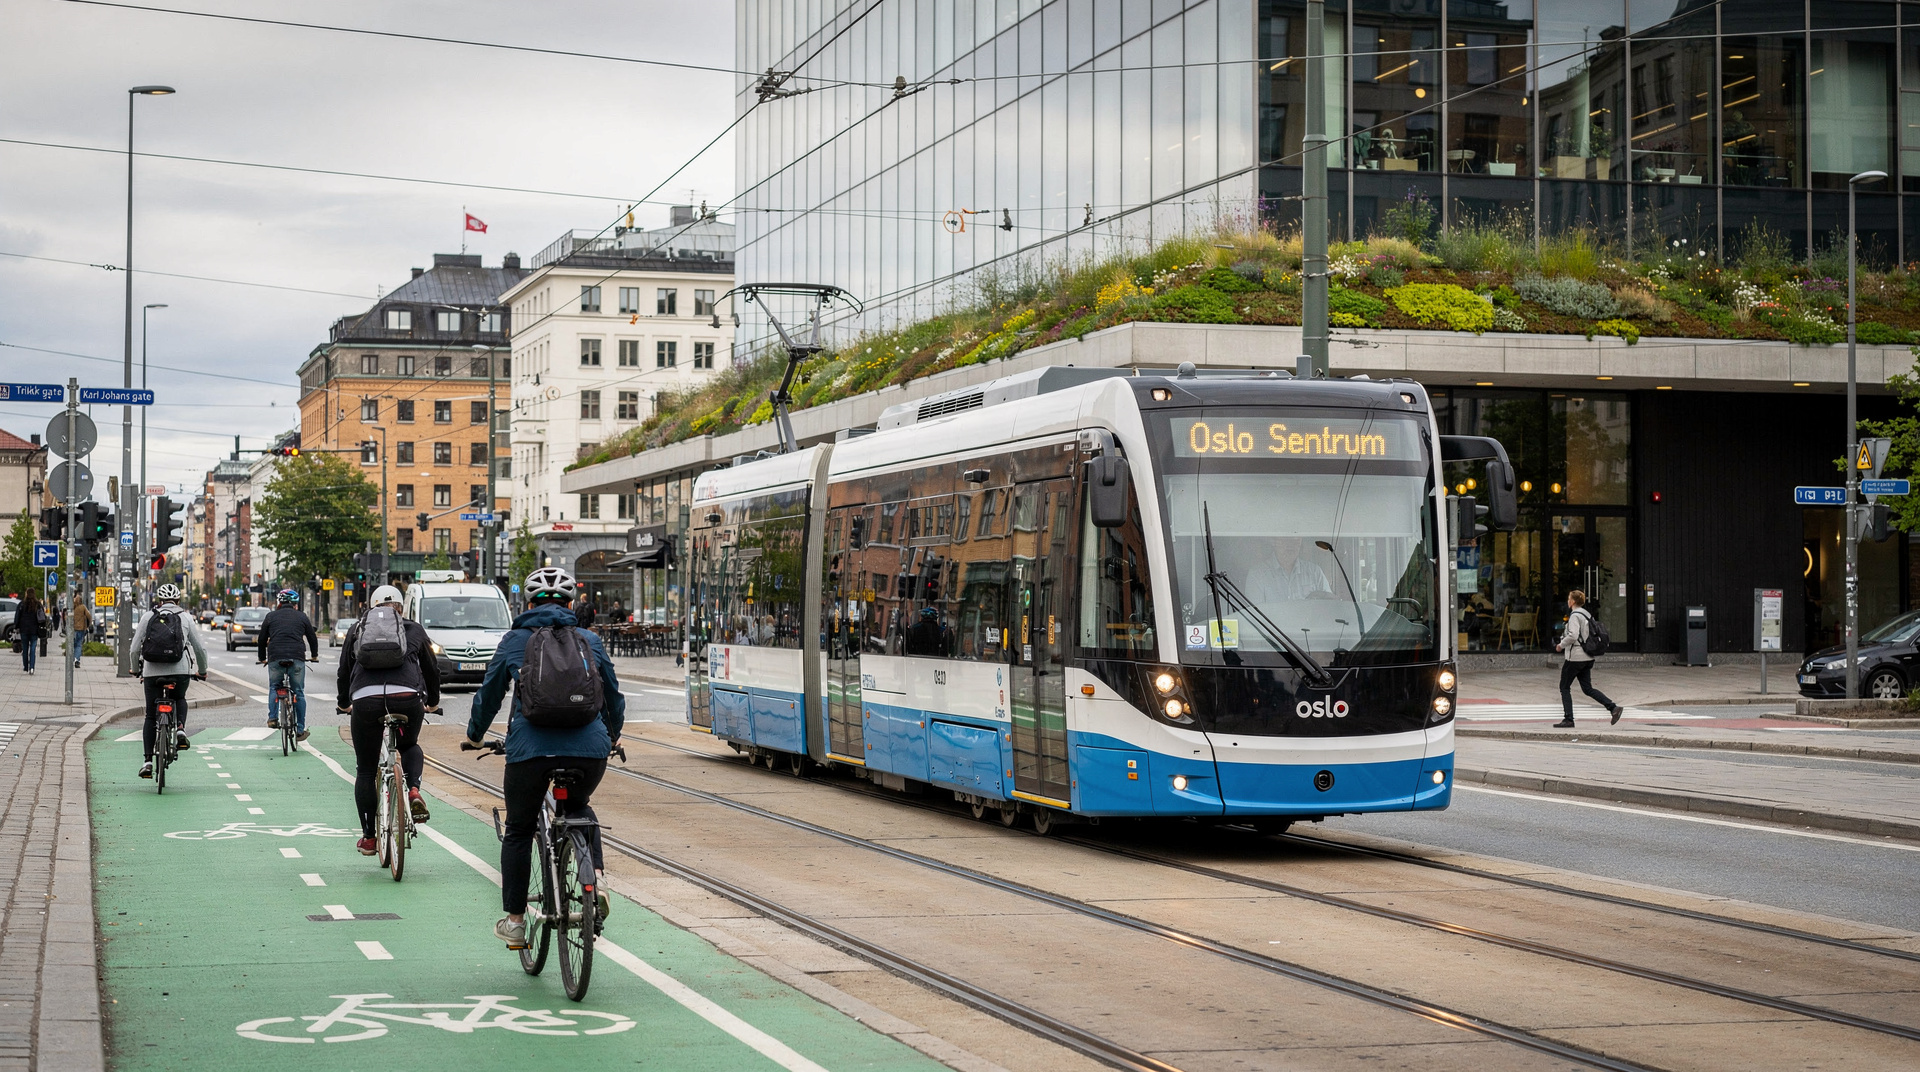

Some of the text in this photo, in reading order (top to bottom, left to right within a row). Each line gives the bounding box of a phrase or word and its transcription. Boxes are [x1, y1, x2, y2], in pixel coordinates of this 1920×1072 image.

[42, 388, 63, 399] gate
[82, 390, 152, 403] Karl Johans gate
[1190, 422, 1386, 456] Oslo Sentrum
[1296, 694, 1350, 719] oslo
